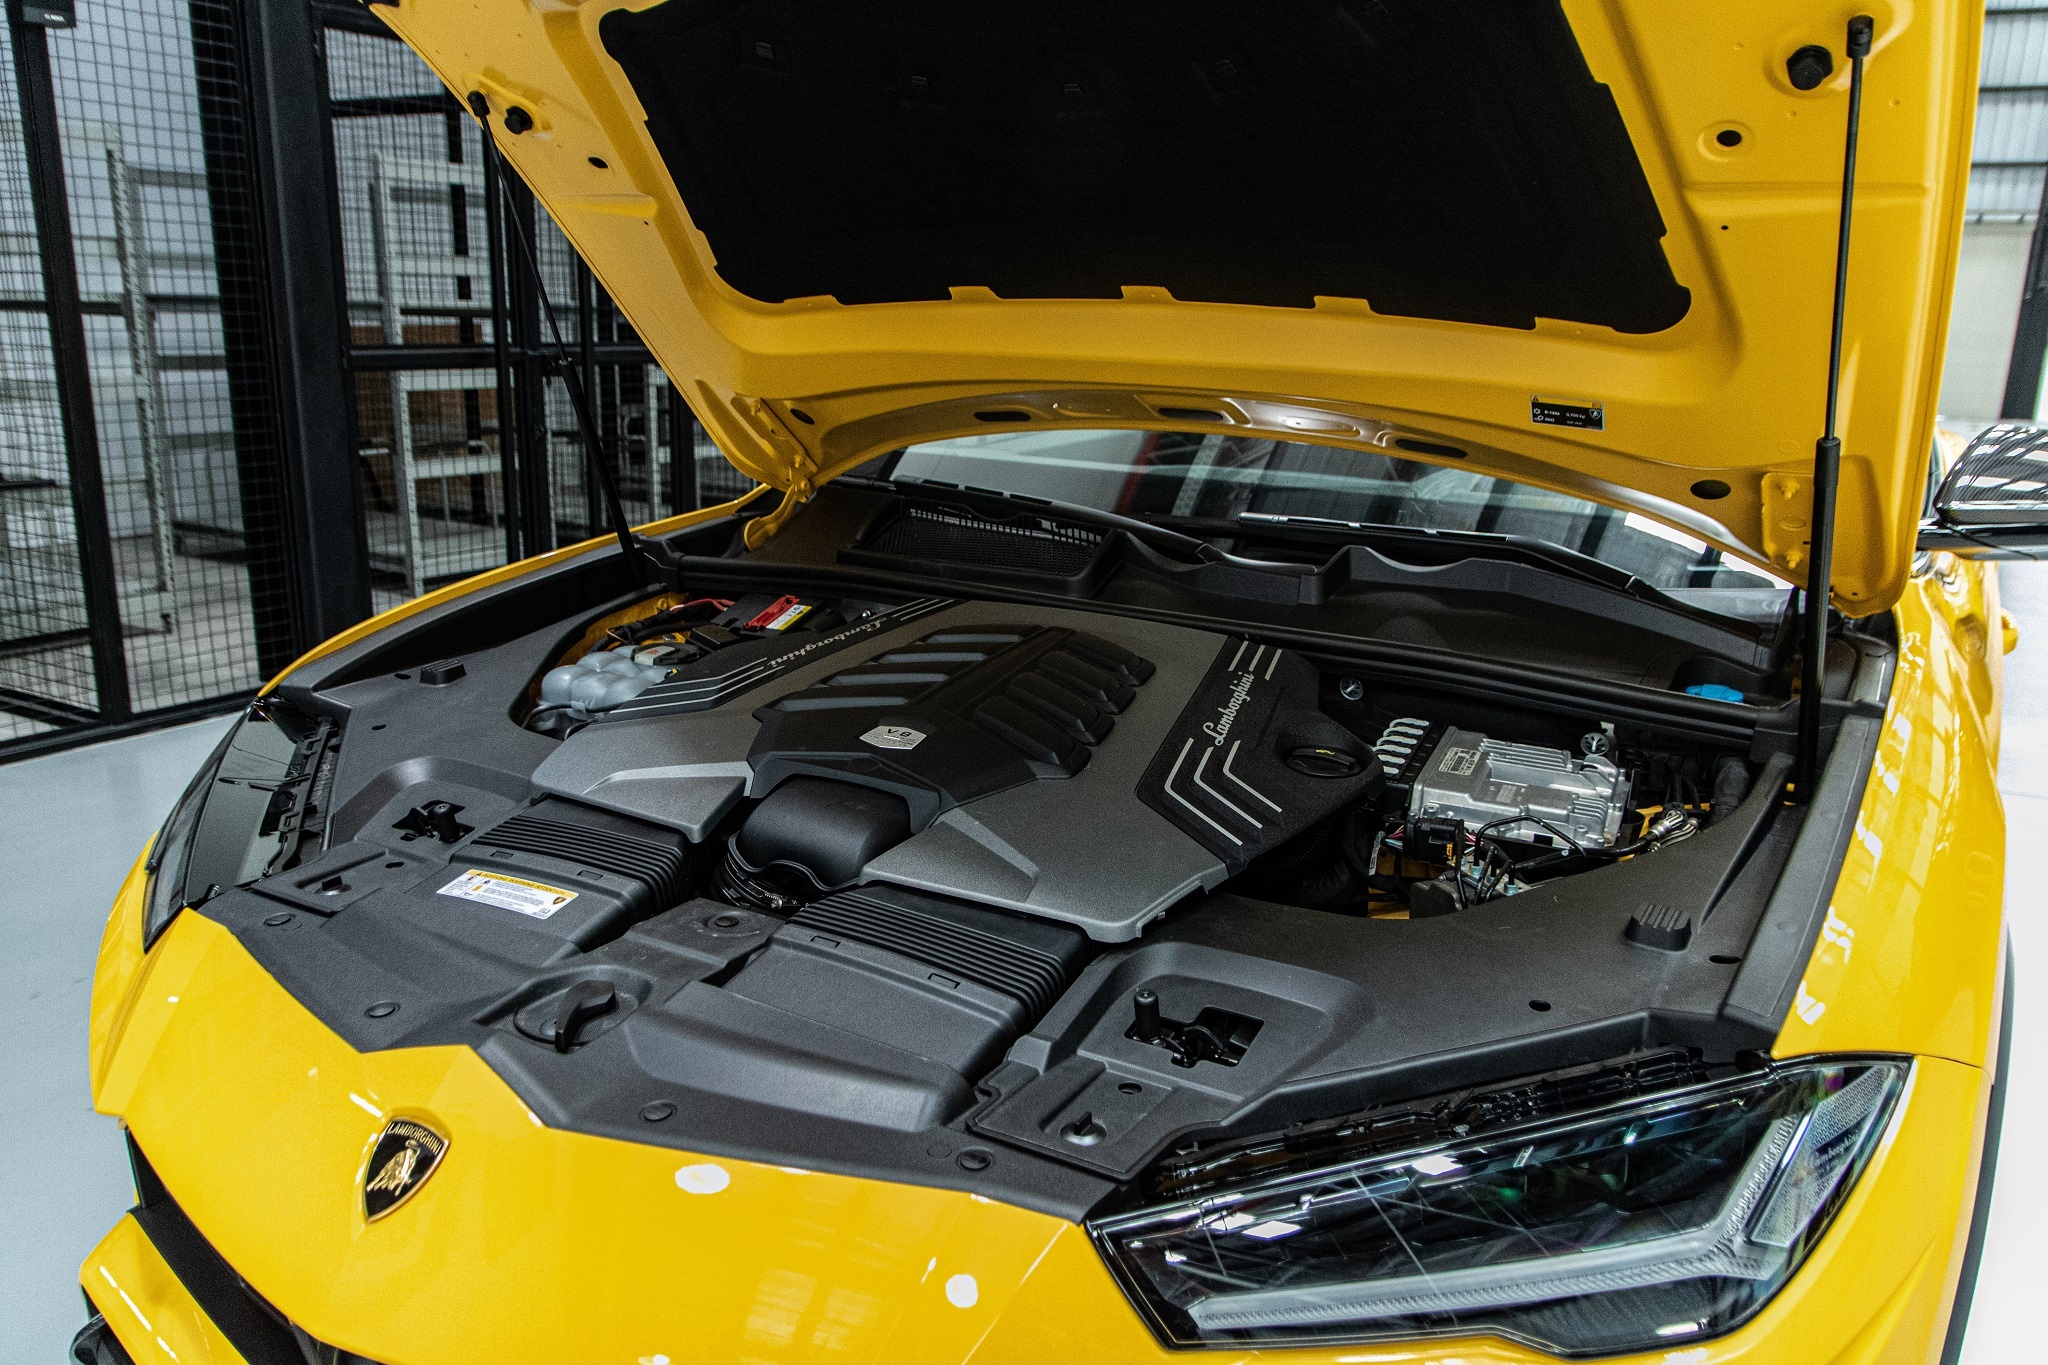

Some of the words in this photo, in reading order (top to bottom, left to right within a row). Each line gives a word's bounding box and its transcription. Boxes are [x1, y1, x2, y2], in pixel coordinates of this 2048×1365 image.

[767, 617, 887, 668] Lamborghini
[1202, 671, 1255, 746] Lamborghini
[386, 1122, 443, 1156] LAMBORGHINI
